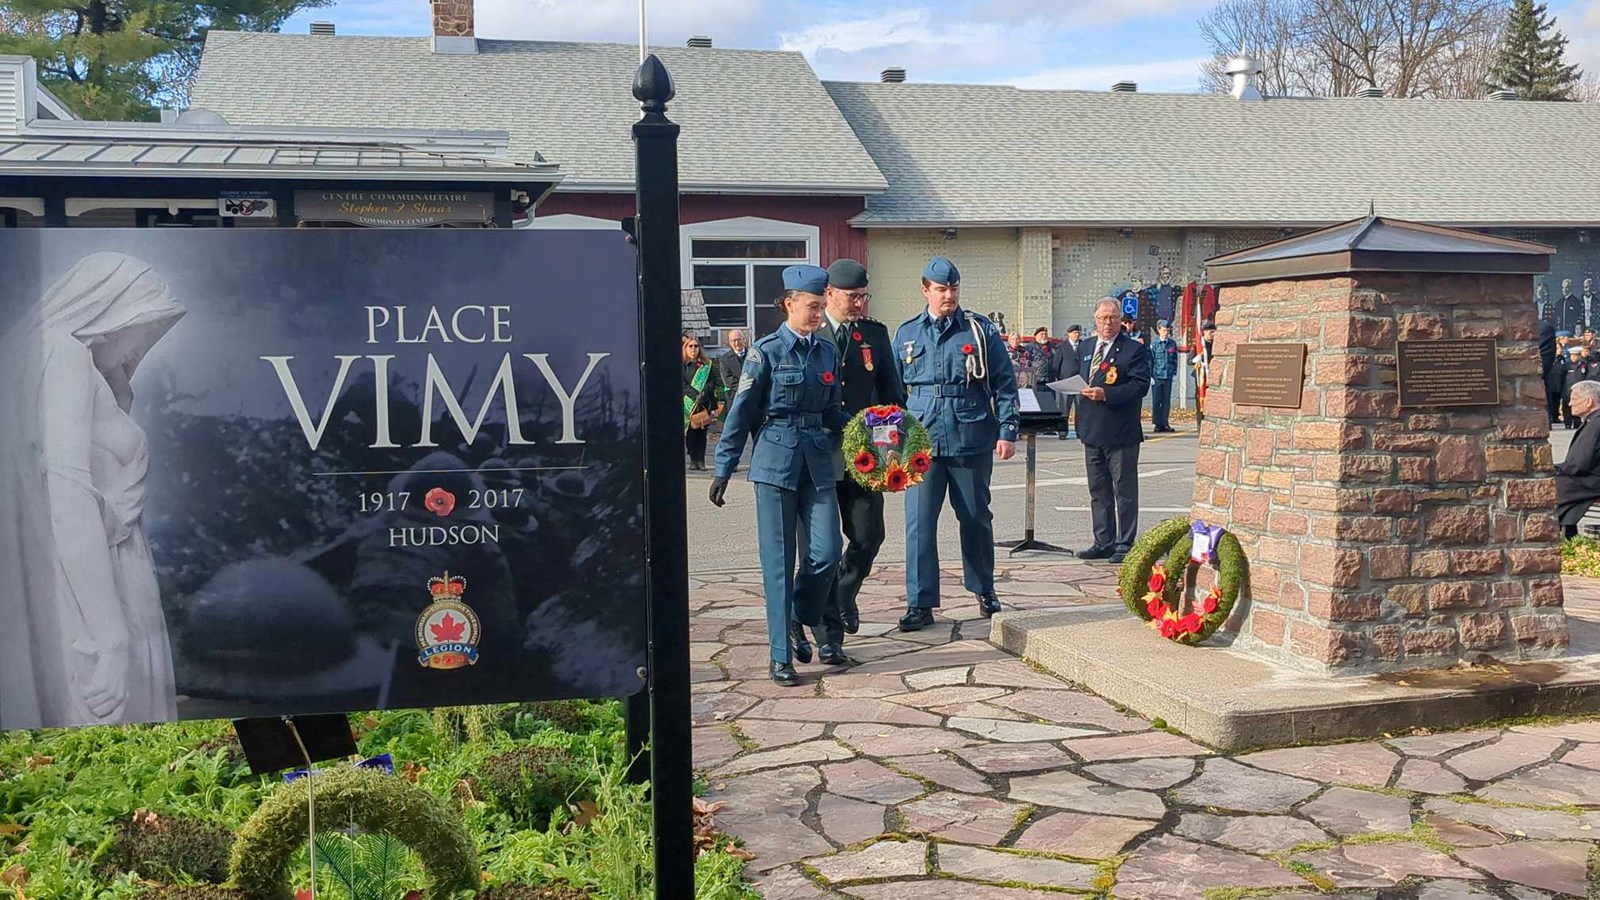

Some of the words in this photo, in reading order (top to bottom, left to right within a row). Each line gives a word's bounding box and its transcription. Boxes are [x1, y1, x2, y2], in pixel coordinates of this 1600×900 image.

[322, 193, 364, 201] CENTRE
[370, 193, 469, 202] COMMUNAUTAIRE
[339, 202, 388, 215] Stephen
[359, 217, 404, 225] COMMUNITY
[365, 305, 512, 343] PLACE
[260, 353, 610, 450] VIMY
[359, 492, 410, 512] 1917
[469, 489, 524, 508] 2017
[390, 525, 499, 547] HUDSON
[424, 644, 472, 656] LEGION
